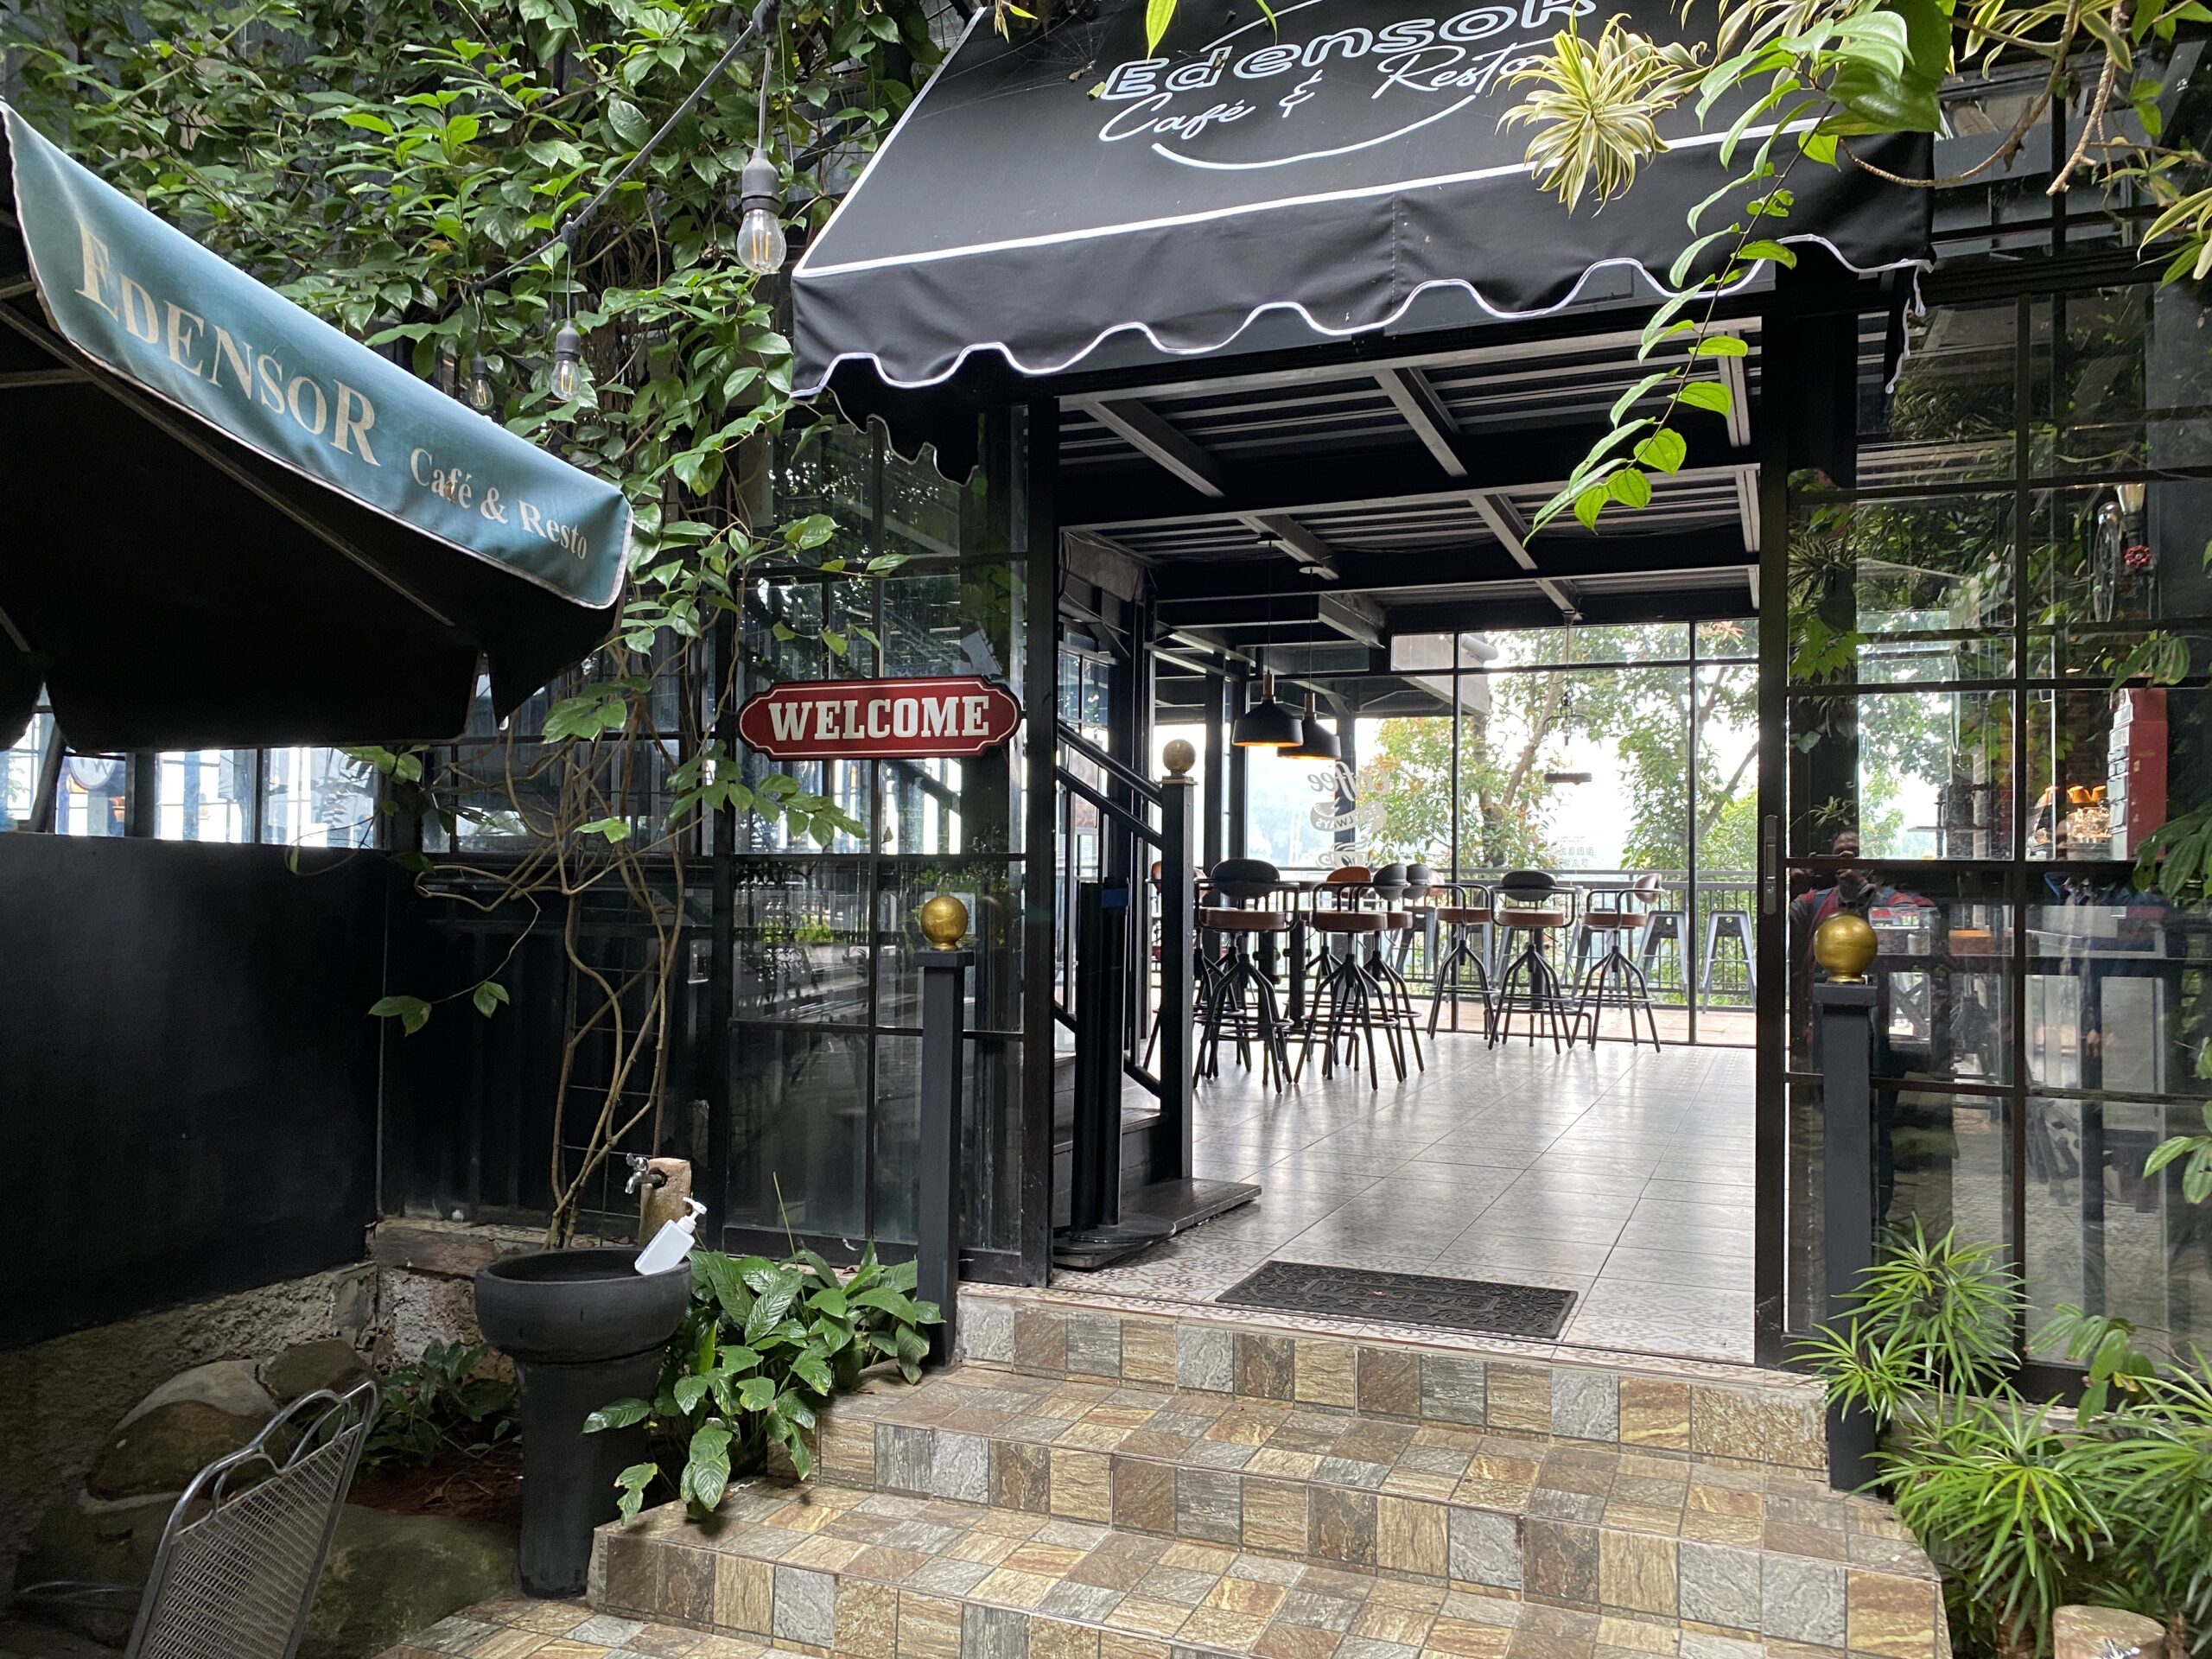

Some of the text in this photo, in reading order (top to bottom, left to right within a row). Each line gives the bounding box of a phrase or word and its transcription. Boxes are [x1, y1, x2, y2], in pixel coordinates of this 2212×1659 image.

[1098, 42, 1557, 142] Café & Resto
[74, 216, 588, 560] EDENSOR Café & Resto
[768, 695, 989, 741] WELCOME
